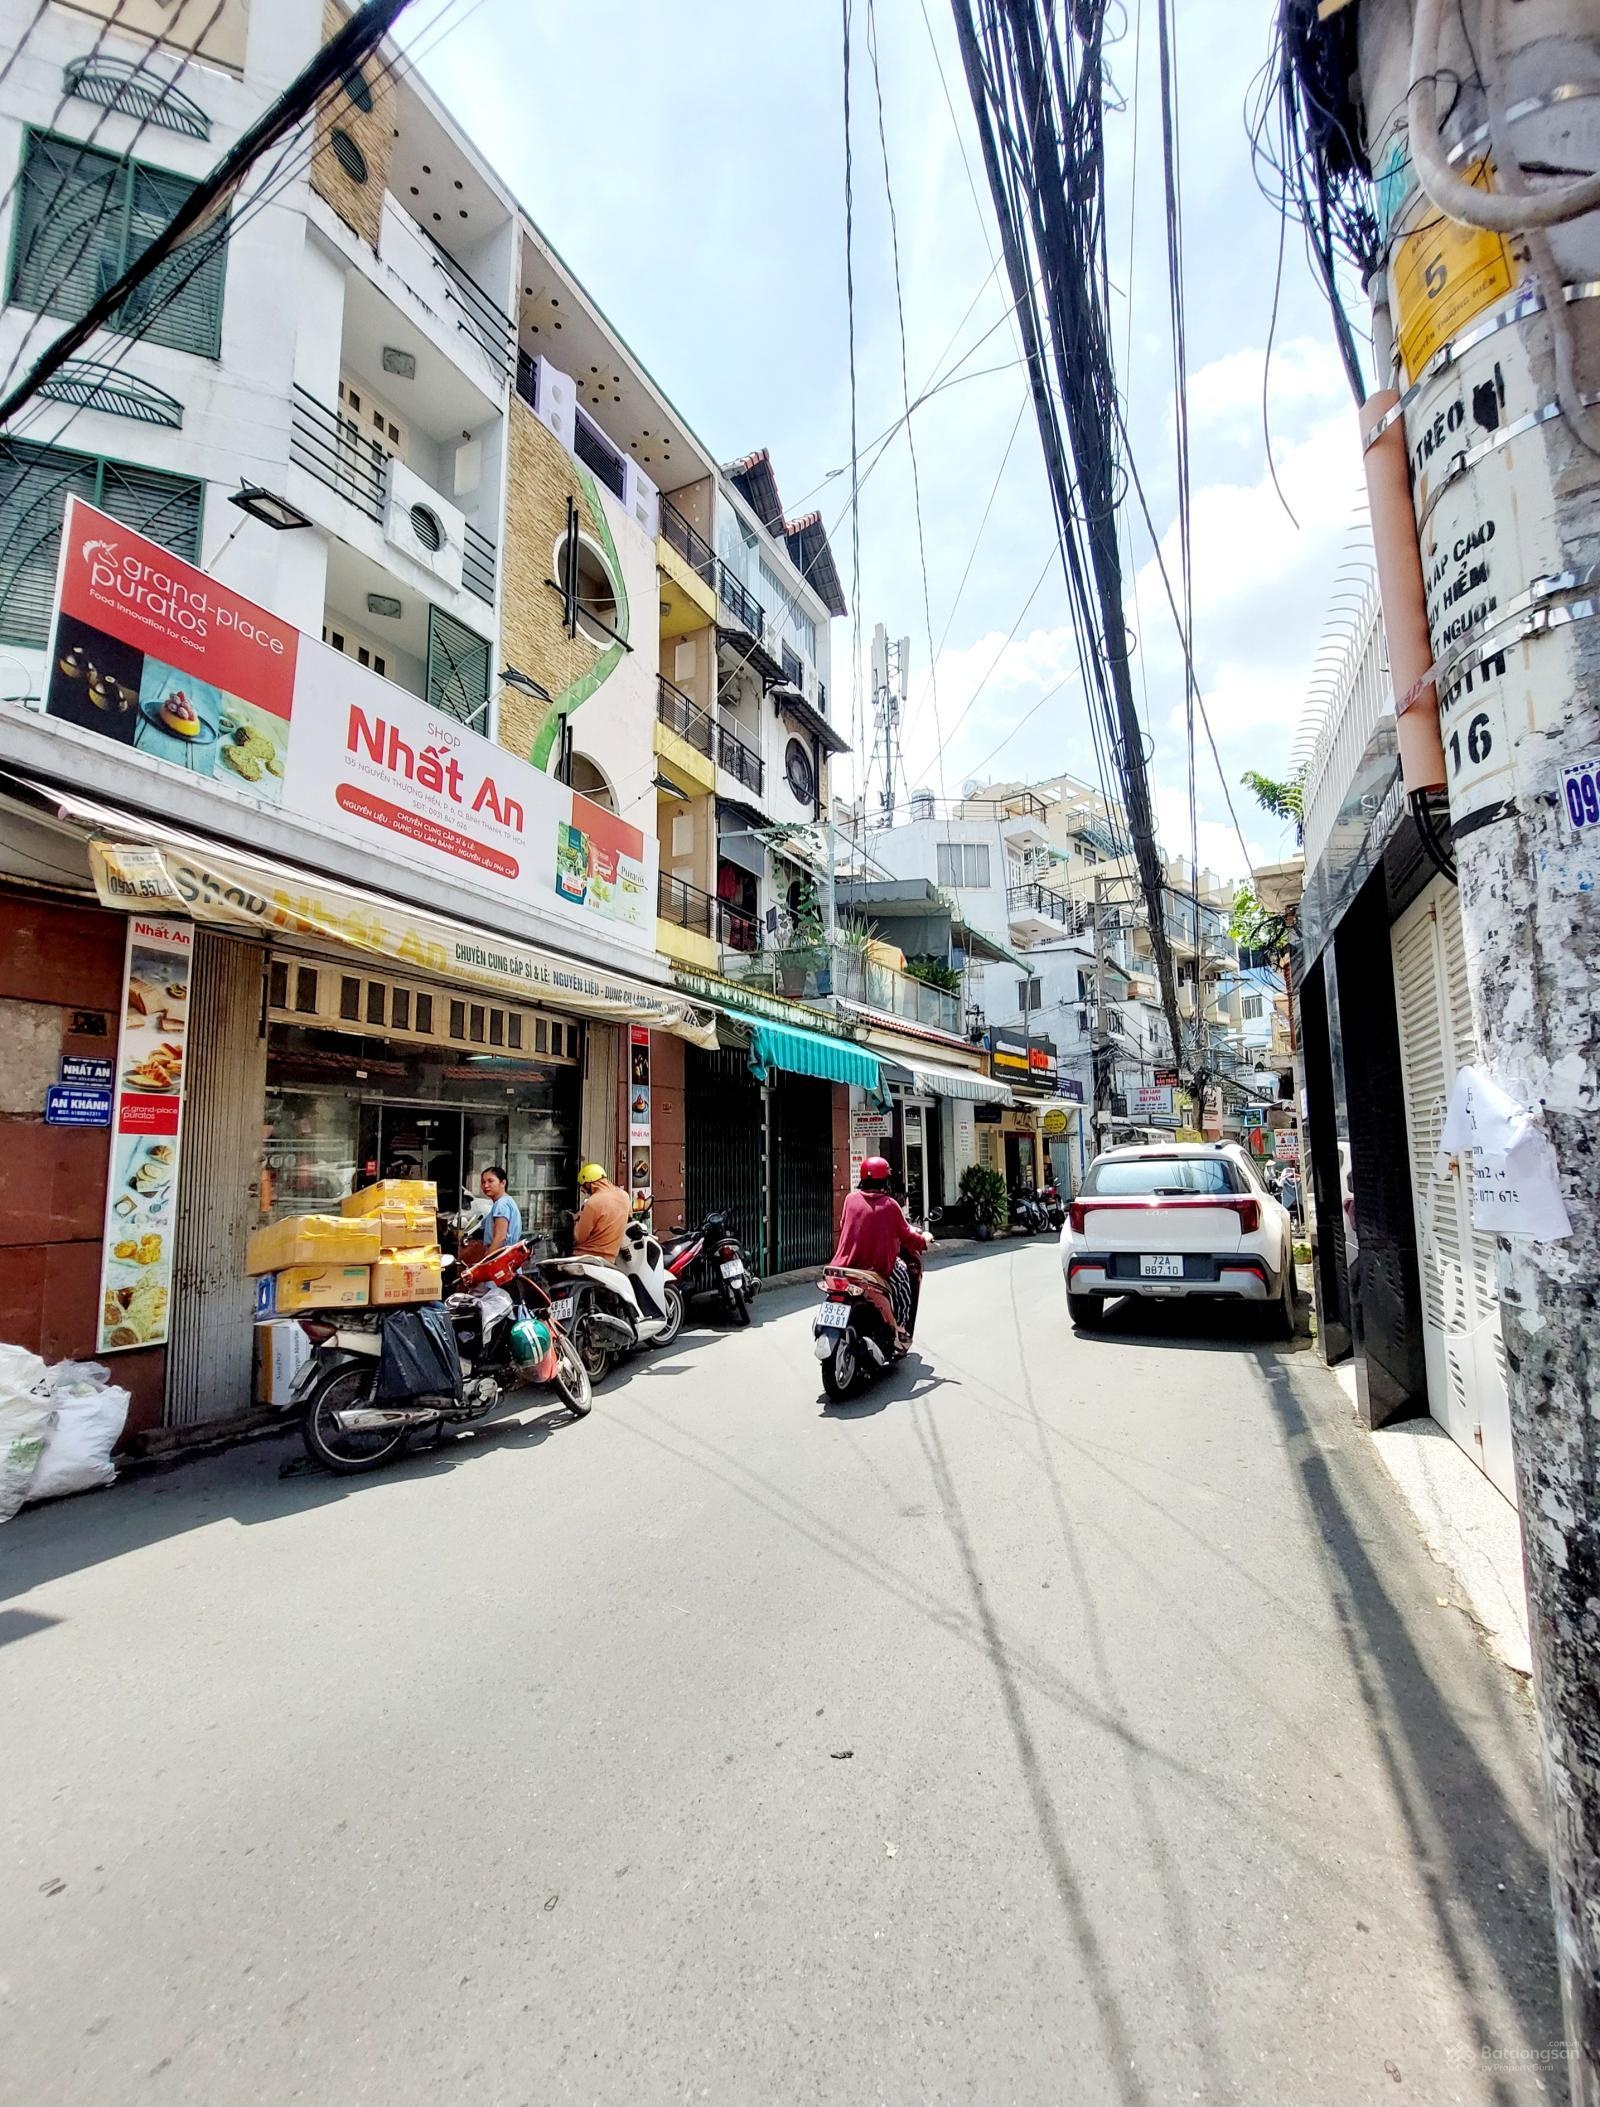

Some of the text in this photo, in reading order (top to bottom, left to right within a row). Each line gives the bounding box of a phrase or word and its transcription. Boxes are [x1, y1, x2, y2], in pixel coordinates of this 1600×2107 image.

[1425, 253, 1447, 299] 5
[1453, 520, 1495, 562] CAO
[89, 588, 206, 653] Food Innovation for Good
[91, 562, 208, 636] puratos
[123, 556, 283, 654] grand-place
[428, 722, 461, 747] SHOP
[1451, 713, 1492, 778] 16
[347, 703, 524, 833] Nhất An
[424, 824, 442, 836] CUNG
[174, 867, 267, 916] Shop
[134, 921, 190, 944] Nhất An
[455, 943, 486, 966] CHUYÊN
[488, 951, 508, 972] CUNG
[509, 956, 524, 976] CẤP
[534, 966, 539, 980] &
[553, 970, 583, 992] NGUYÊN
[584, 978, 600, 999] LIỆU
[605, 985, 623, 1005] DỤNG
[63, 1063, 110, 1078] NHẤT AN
[51, 1098, 108, 1111] AN KHÁNH
[1145, 1266, 1178, 1275] 887.10
[1152, 1256, 1170, 1265] 72A
